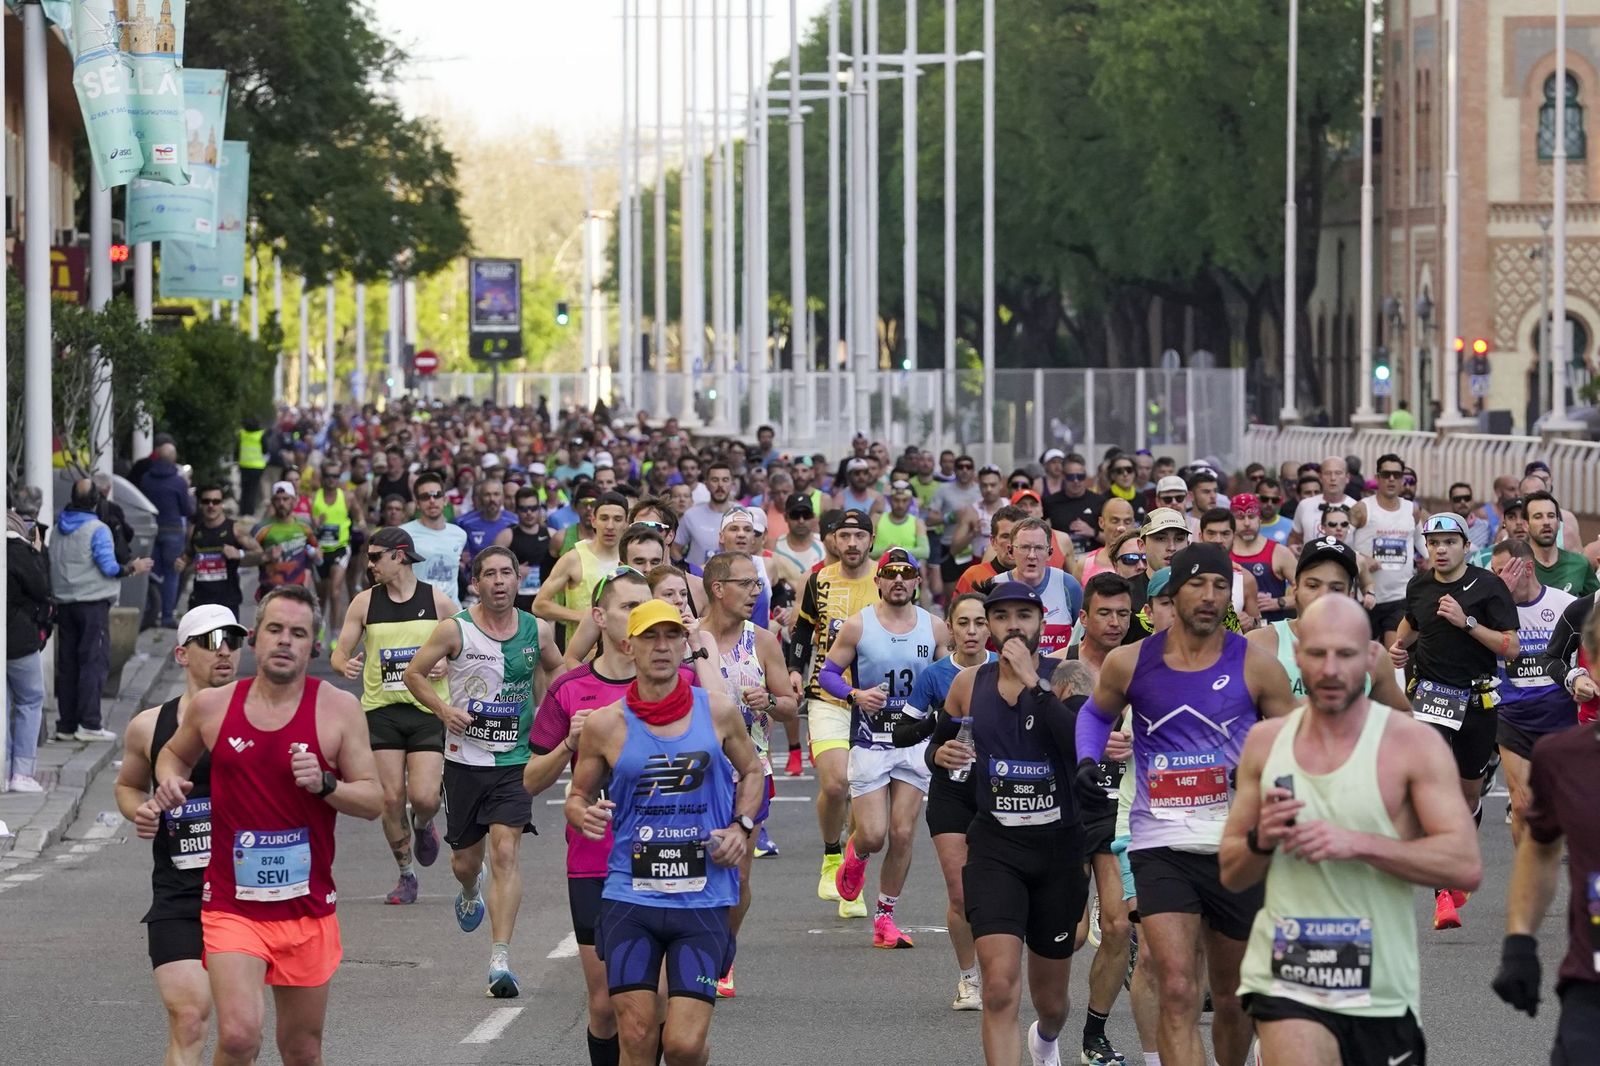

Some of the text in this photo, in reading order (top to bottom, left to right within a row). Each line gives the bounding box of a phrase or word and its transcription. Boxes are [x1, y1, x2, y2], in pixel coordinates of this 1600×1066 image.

[917, 645, 929, 658] RB
[1519, 643, 1548, 652] ZURICH
[465, 653, 497, 662] GIVOVA
[386, 671, 404, 681] DAV
[1517, 666, 1543, 677] CANO
[884, 669, 913, 697] 13
[1435, 685, 1465, 697] ZURICH
[1433, 696, 1449, 706] 4293
[486, 705, 515, 714] ZURICH
[1422, 703, 1454, 718] PABLO
[485, 719, 501, 728] 3581
[465, 725, 518, 741] JOSÉ CRUZ
[1172, 754, 1215, 766] ZURICH
[1012, 765, 1050, 775] ZURICH
[1175, 776, 1198, 786] 1467
[1013, 784, 1035, 794] 3582
[996, 794, 1054, 811] ESTEVÃO
[1151, 793, 1229, 807] MARCELO AVELAR
[185, 802, 212, 814] ZURI
[188, 822, 212, 834] 3920
[657, 827, 698, 838] ZURICH
[259, 832, 301, 845] ZURICH
[658, 849, 681, 859] 4094
[261, 856, 285, 866] 8740
[651, 862, 689, 877] FRAN
[257, 869, 289, 885] SEVI
[1305, 922, 1361, 936] ZURICH
[1280, 964, 1363, 987] GRAHAM
